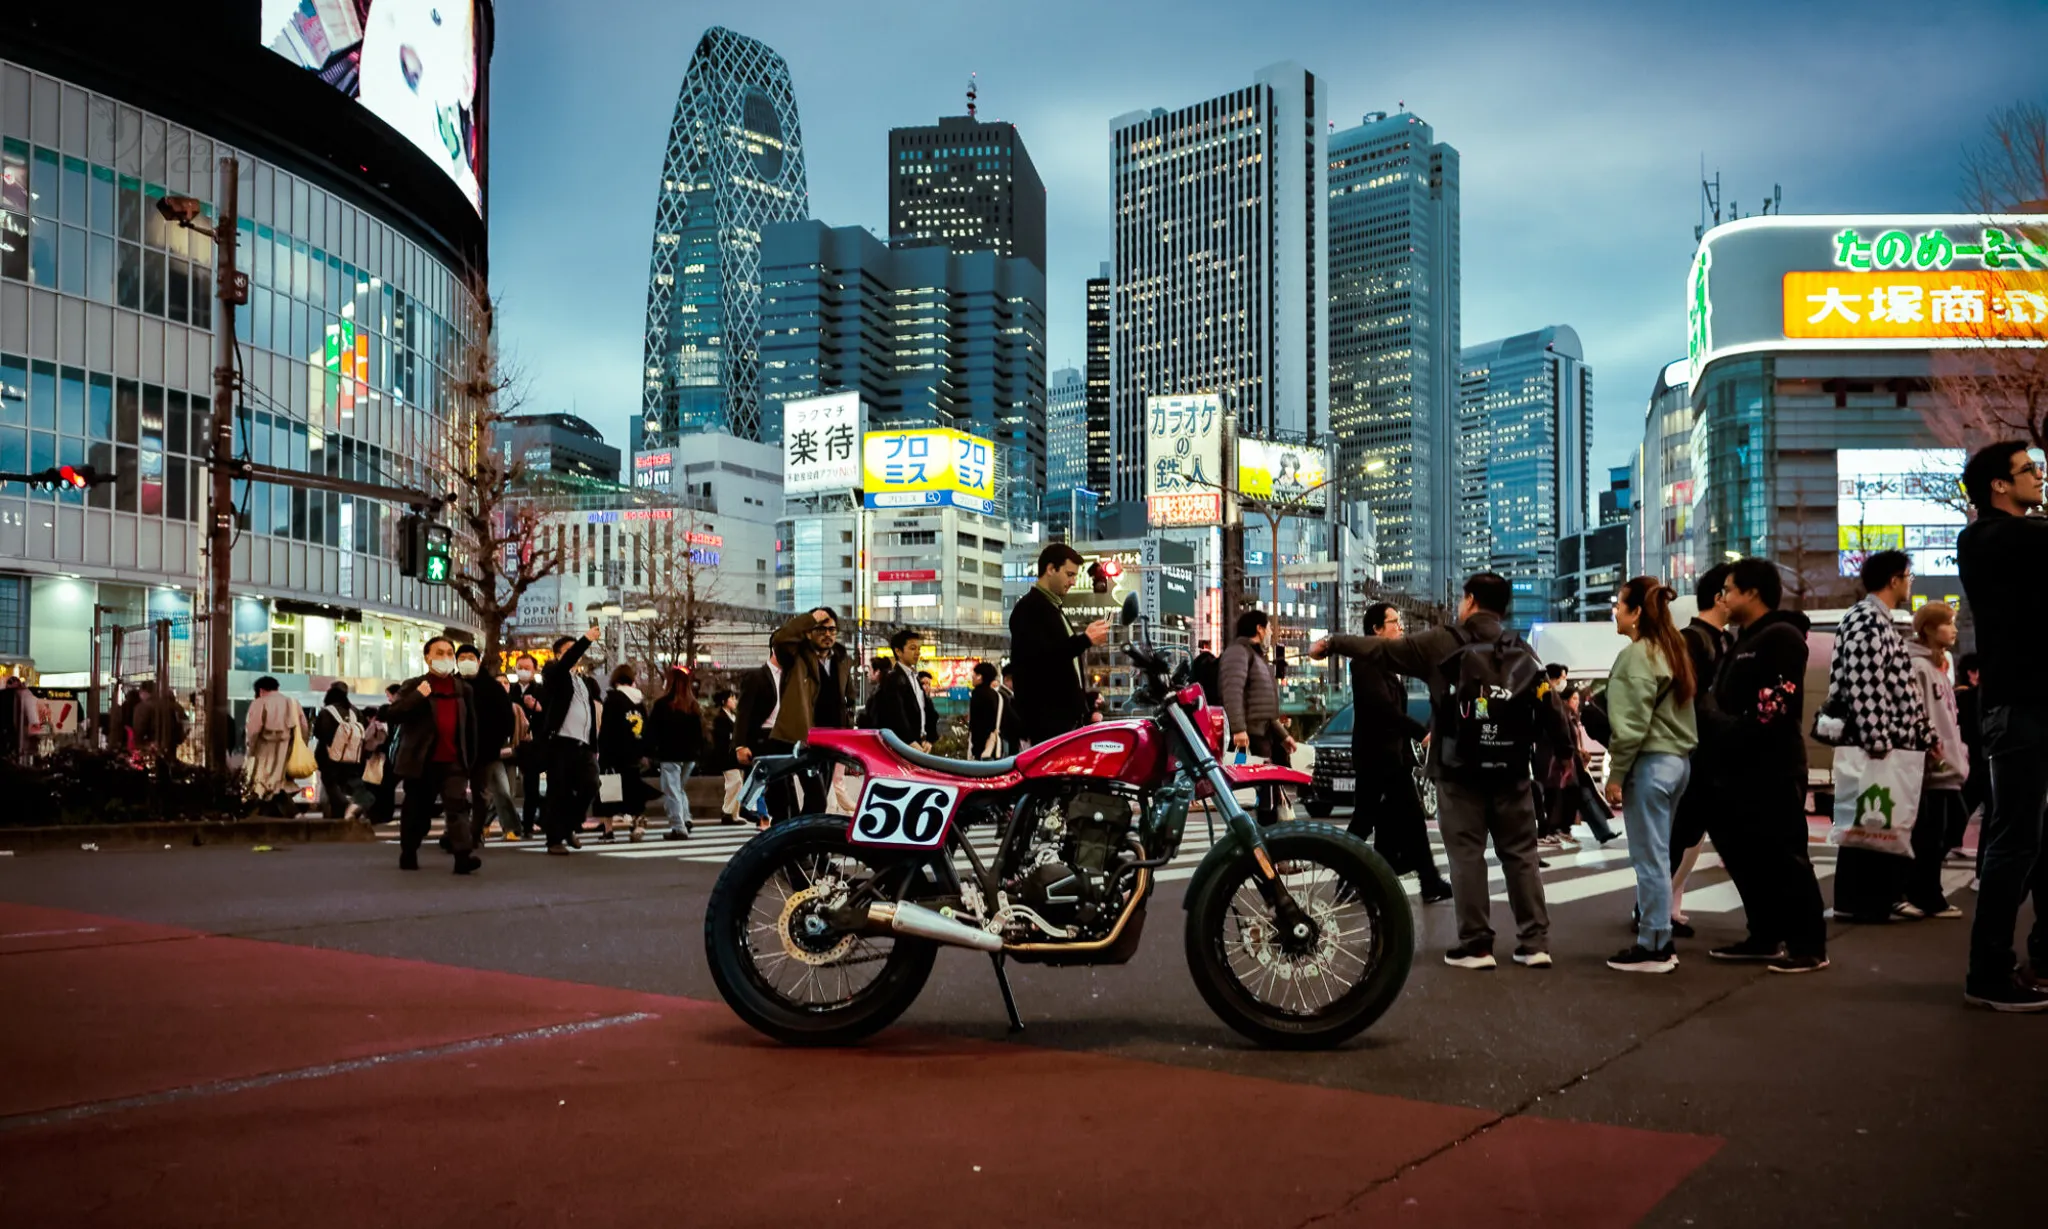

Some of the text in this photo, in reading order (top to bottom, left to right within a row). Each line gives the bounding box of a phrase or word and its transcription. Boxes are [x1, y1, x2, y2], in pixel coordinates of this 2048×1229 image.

[797, 405, 844, 423] ラクマチ
[1150, 399, 1217, 437] カラオケ
[789, 423, 854, 465] 楽待
[884, 434, 928, 459] プロ
[958, 438, 985, 465] プロ
[1175, 436, 1190, 456] の
[884, 463, 928, 484] ミス
[958, 465, 985, 490] ミス
[524, 606, 555, 615] OPEN
[859, 782, 950, 842] 56
